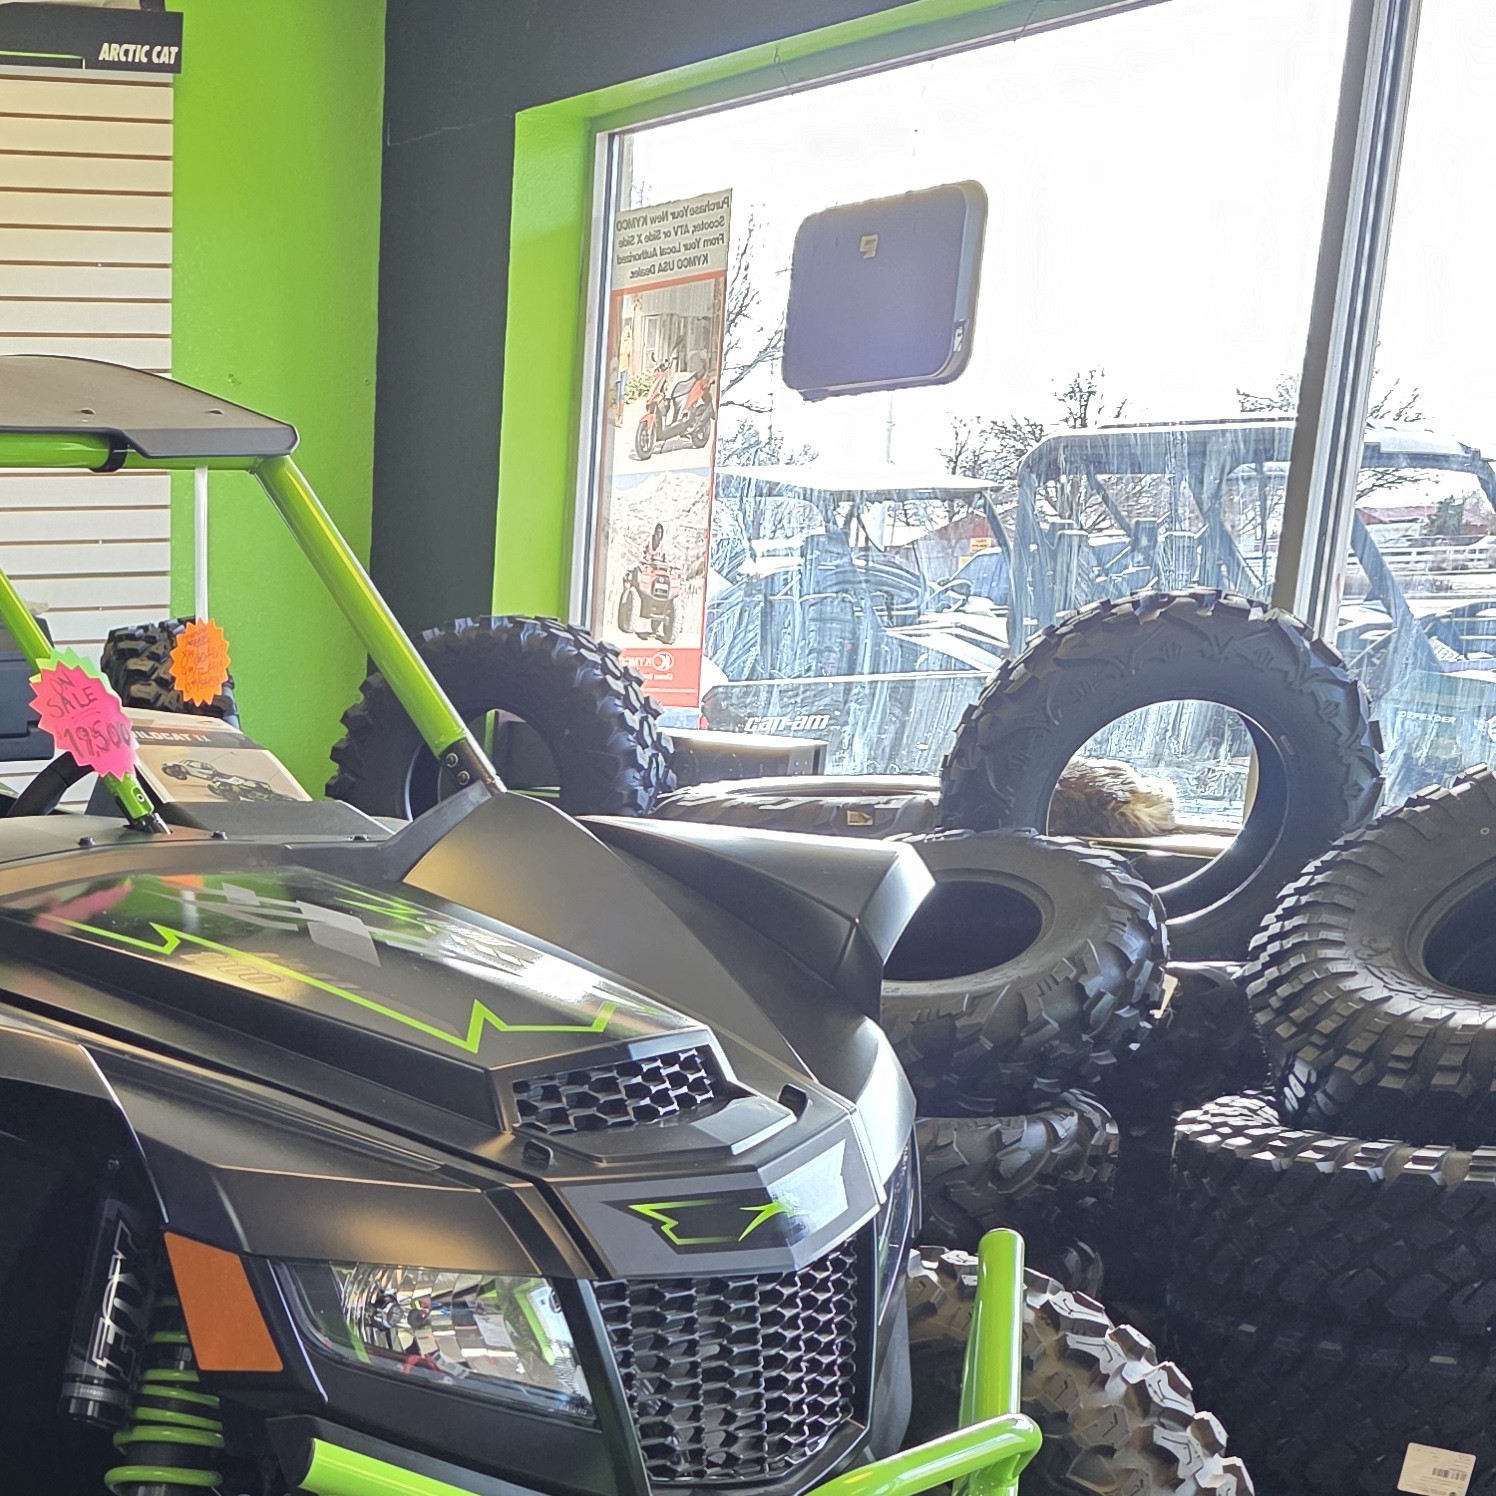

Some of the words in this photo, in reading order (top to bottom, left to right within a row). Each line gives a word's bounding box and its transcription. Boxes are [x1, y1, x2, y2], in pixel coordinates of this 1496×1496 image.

[98, 42, 150, 63] ARCTIC
[152, 45, 179, 64] CAT
[48, 671, 76, 695] ON
[46, 686, 99, 719] SALE
[744, 713, 831, 732] can-am
[92, 1218, 150, 1384] FOX
